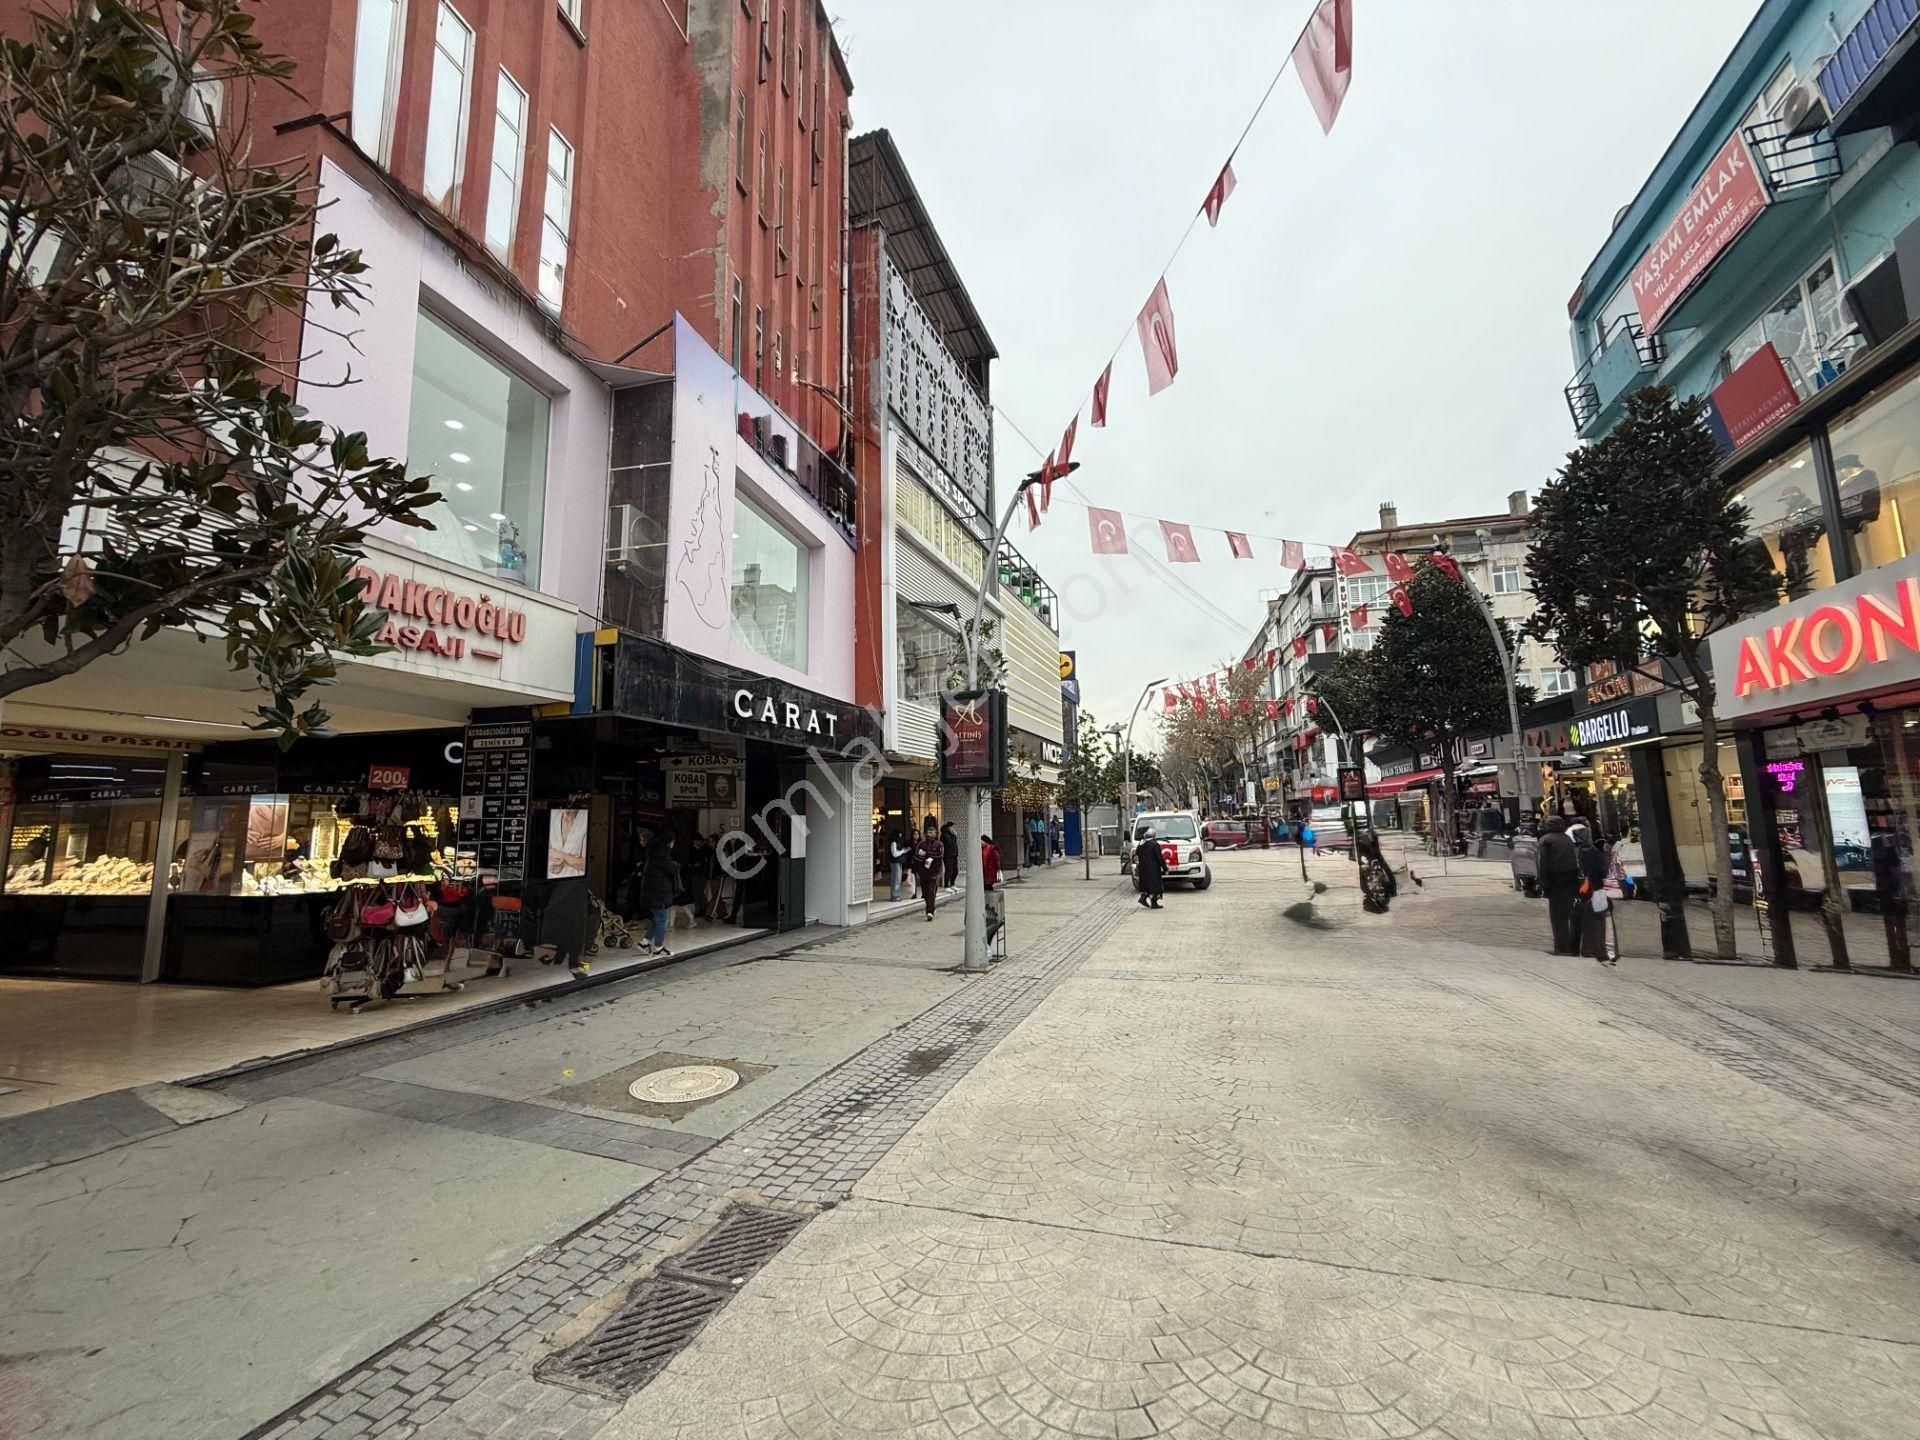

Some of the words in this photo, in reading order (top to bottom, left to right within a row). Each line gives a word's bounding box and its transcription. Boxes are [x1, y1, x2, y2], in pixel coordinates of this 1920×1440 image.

[1634, 231, 1684, 297] YAŞAM
[1683, 147, 1745, 234] EMLAK
[1652, 271, 1676, 300] VİLLA
[1679, 241, 1701, 271] ARSA
[1705, 197, 1736, 237] DAİRE
[349, 564, 528, 643] DAKÇIOĞLU
[373, 621, 466, 660] ASAJI
[734, 688, 838, 737] CARAT
[1578, 709, 1630, 747] BARGELLO
[101, 735, 191, 750] PASAJI
[502, 738, 516, 746] KAT
[688, 755, 729, 766] KOBAŞ
[674, 772, 705, 787] KOBAŞ
[90, 790, 122, 799] CARAT
[223, 785, 258, 794] CARAT
[303, 785, 355, 794] CARAT
[680, 786, 699, 794] SPOR
[31, 793, 60, 802] CARAT
